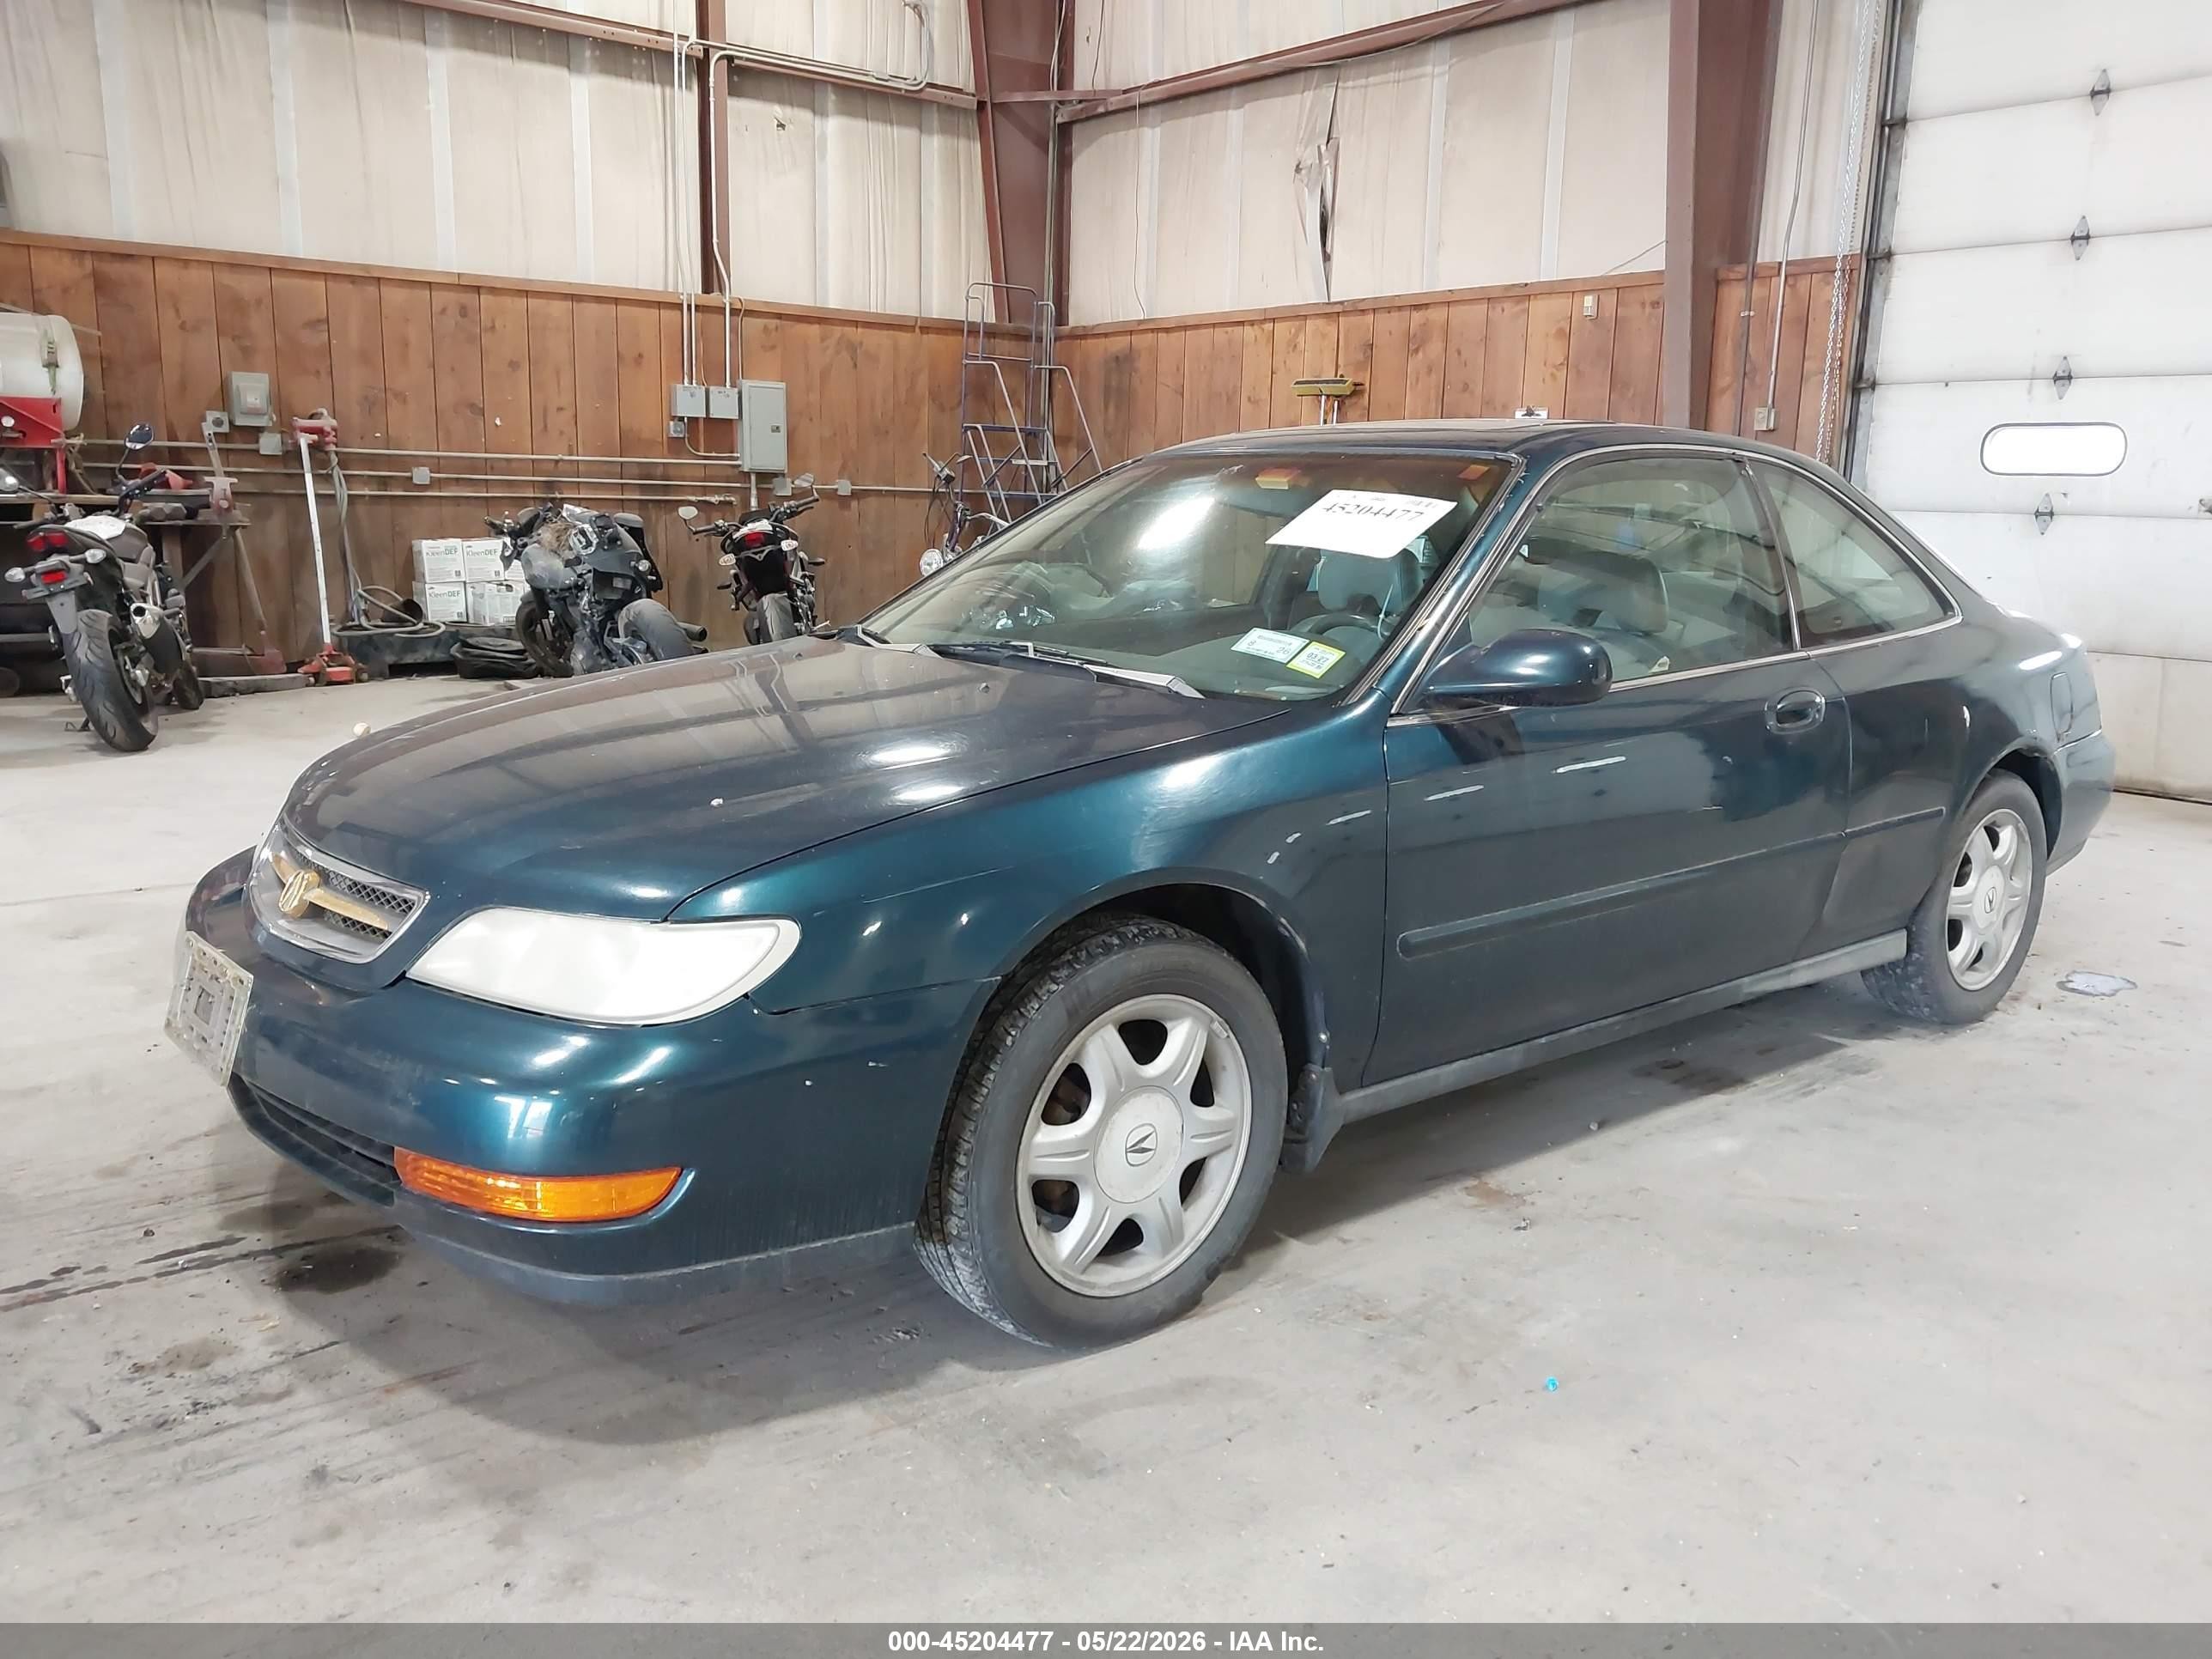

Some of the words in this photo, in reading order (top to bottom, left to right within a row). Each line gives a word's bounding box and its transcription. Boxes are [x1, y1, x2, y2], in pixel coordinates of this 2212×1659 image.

[1322, 502, 1425, 521] 45204477
[466, 549, 498, 557] KleenDEF
[428, 590, 461, 599] KleenDEF
